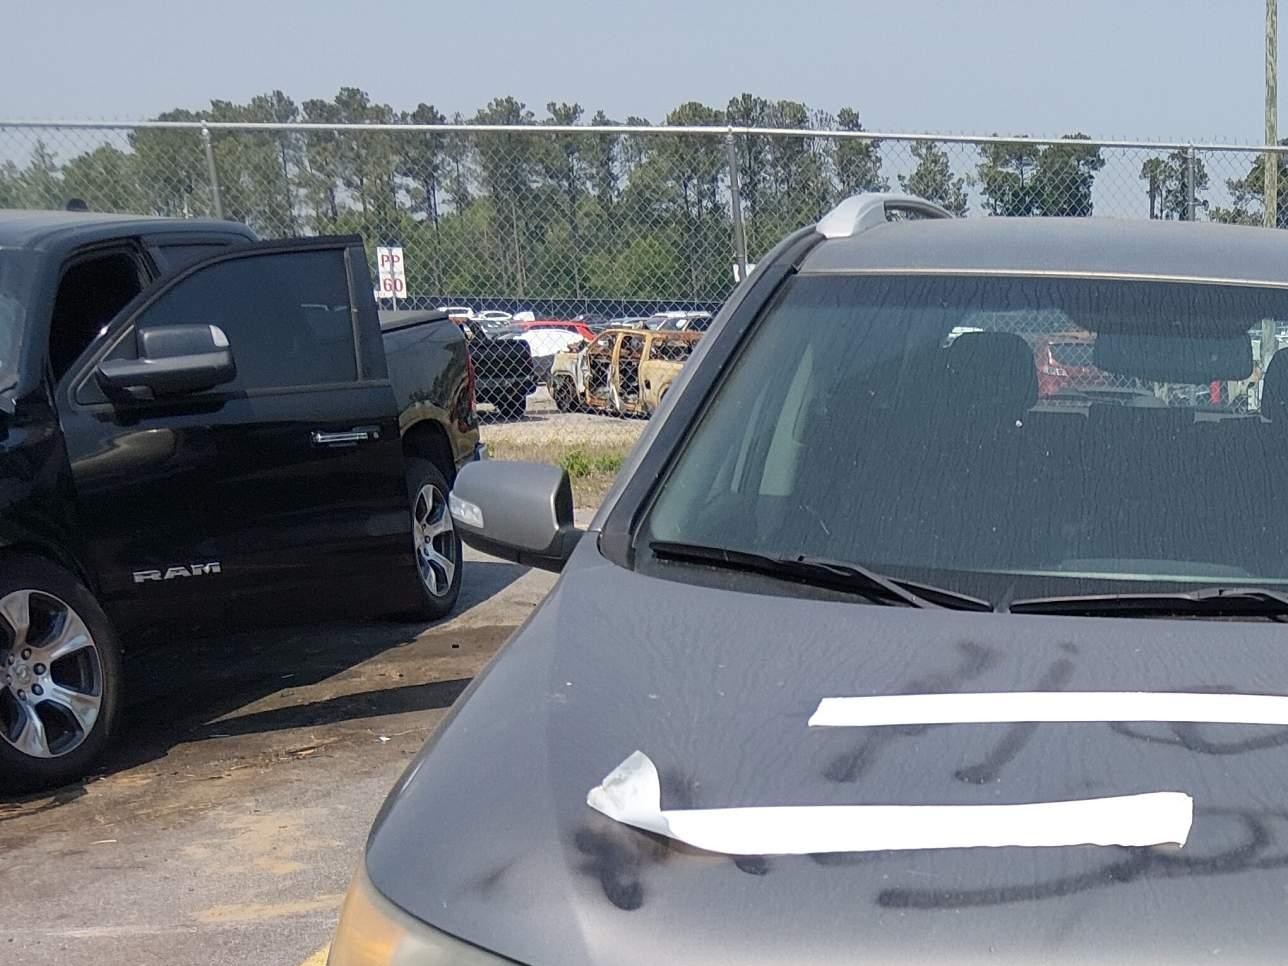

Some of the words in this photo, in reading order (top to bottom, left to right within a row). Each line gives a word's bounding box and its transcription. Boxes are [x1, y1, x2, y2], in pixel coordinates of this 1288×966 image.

[381, 254, 401, 267] PP
[383, 278, 404, 292] 60
[132, 561, 222, 583] RAM
